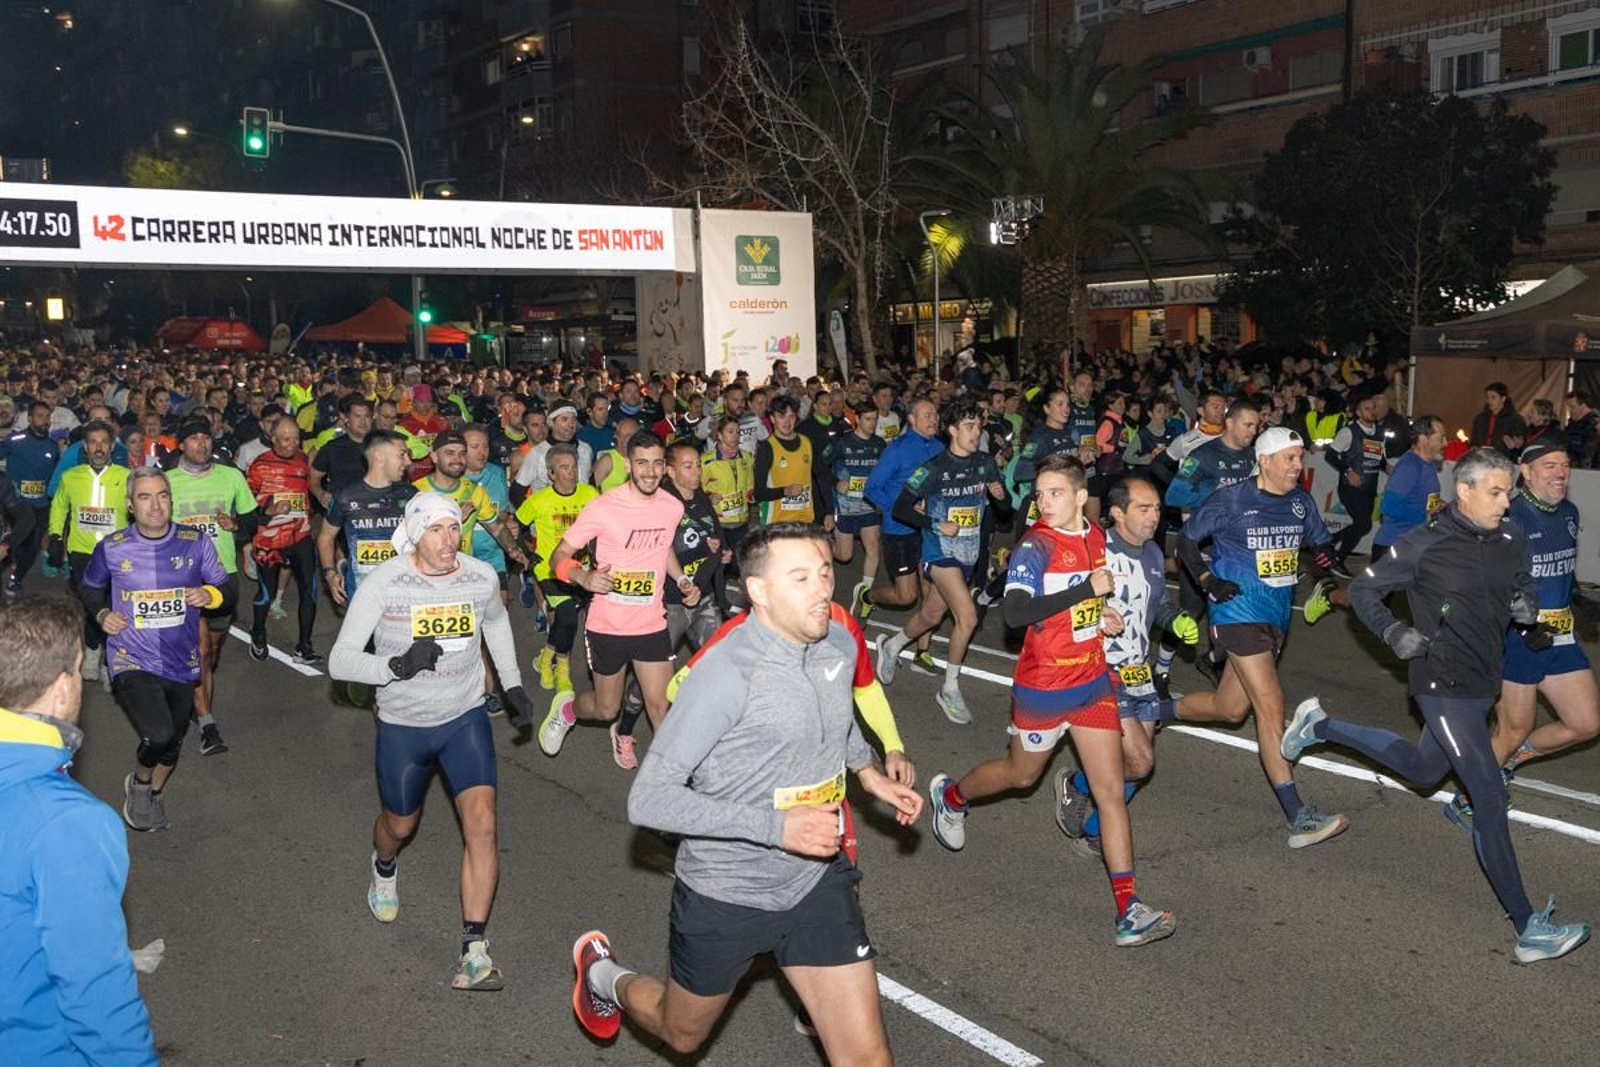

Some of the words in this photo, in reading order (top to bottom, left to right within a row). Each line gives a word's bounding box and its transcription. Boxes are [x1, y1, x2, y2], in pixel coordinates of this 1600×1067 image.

[93, 214, 126, 241] 42
[131, 216, 237, 244] CARRERA
[242, 221, 323, 246] URBANA
[328, 223, 486, 249] INTERNACIONAL
[490, 227, 547, 250] NOCHE
[552, 228, 574, 250] DE
[578, 229, 610, 251] SAN
[351, 518, 374, 530] SAN
[1247, 527, 1269, 536] CLUB
[625, 528, 668, 550] NIKE
[1532, 553, 1554, 564] CLUB
[137, 599, 183, 615] 9458
[417, 615, 471, 636] 3628
